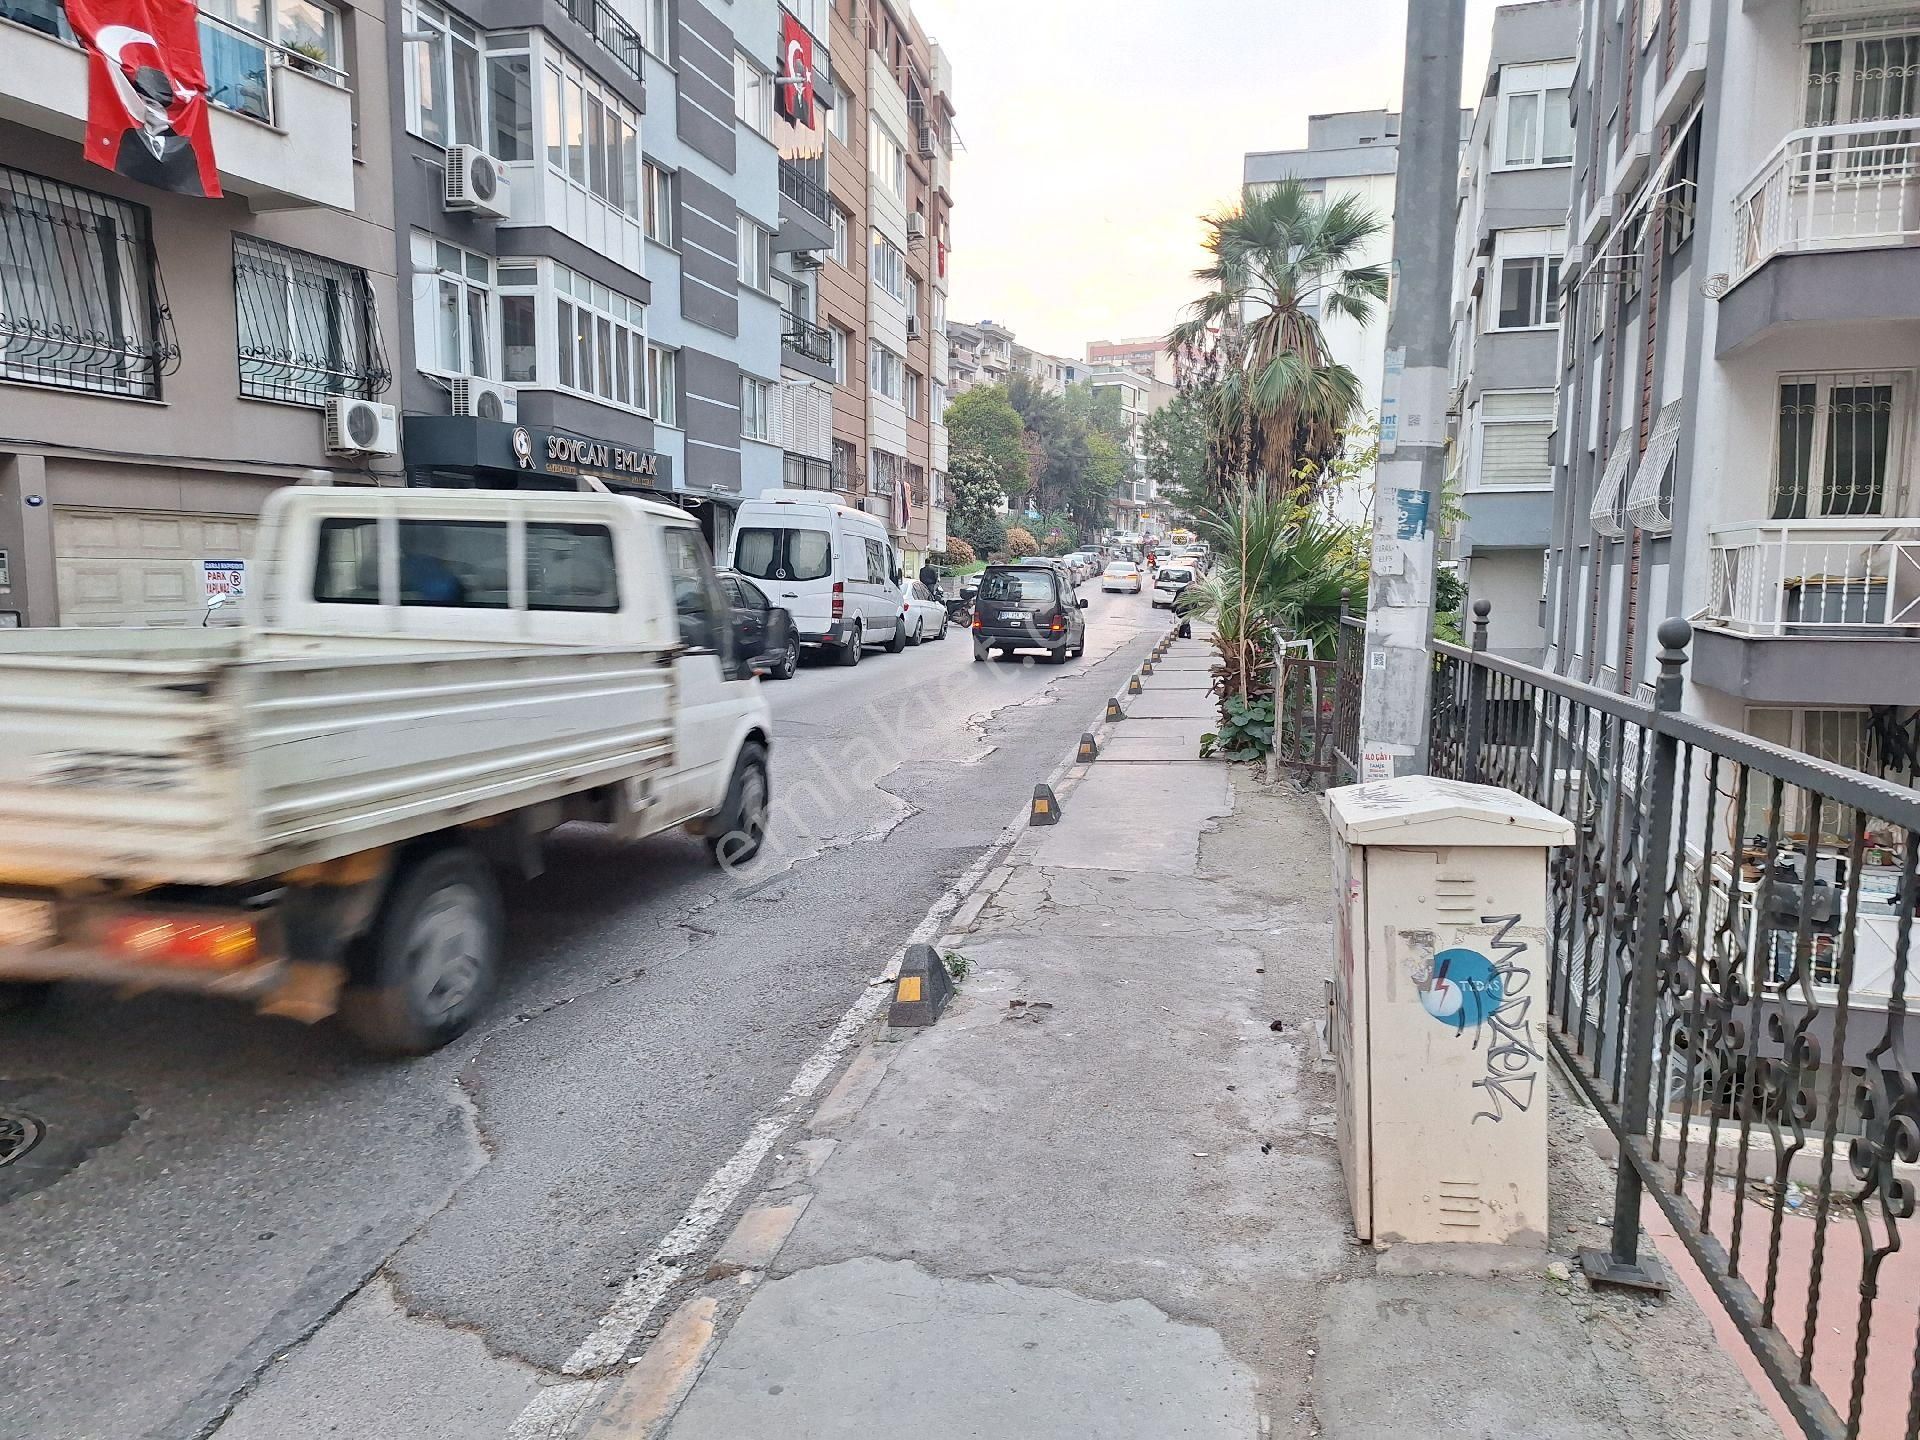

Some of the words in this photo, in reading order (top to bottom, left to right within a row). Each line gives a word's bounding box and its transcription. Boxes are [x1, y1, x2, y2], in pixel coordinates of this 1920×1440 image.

[548, 435, 609, 468] SOYCAN
[614, 447, 658, 475] EMLAK
[207, 572, 226, 580] PARK
